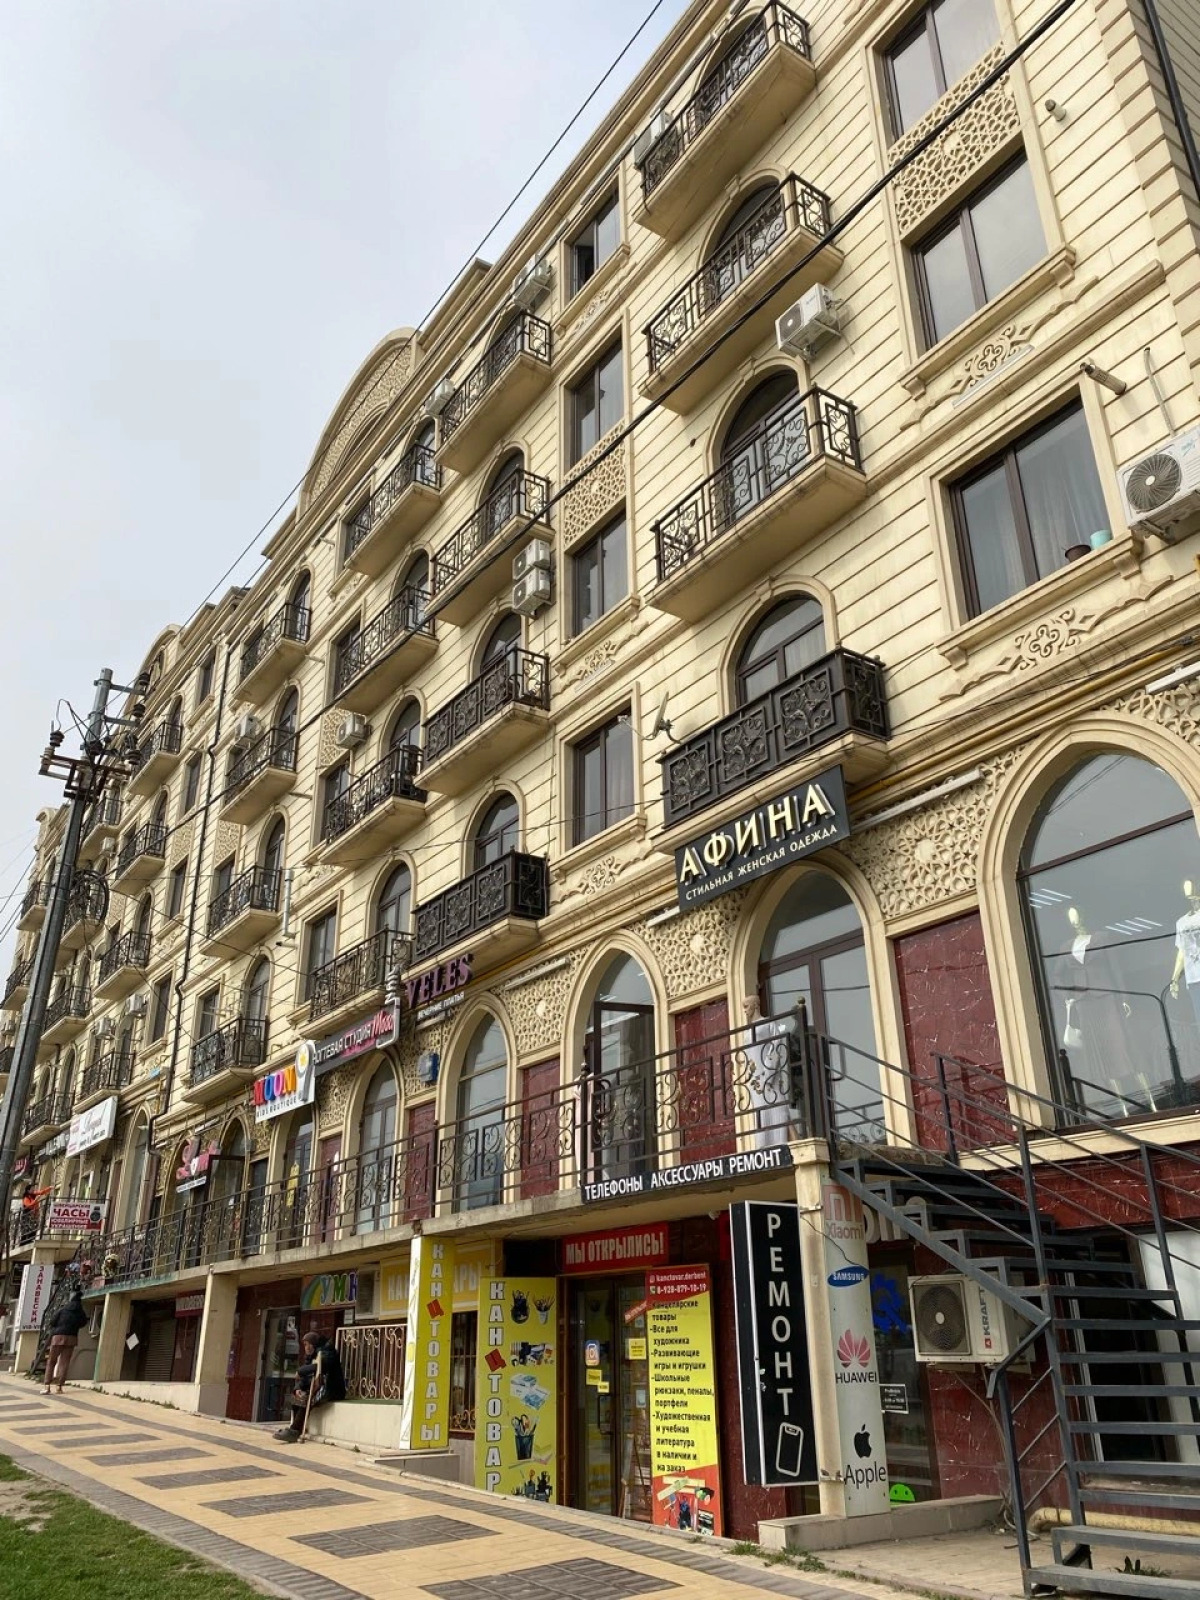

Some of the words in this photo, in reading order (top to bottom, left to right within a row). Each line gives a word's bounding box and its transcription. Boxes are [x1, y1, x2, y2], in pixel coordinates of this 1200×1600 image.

[680, 784, 836, 885] АФИНА
[685, 870, 734, 901] СТИЛЬНАЯ
[737, 848, 786, 877] ЖЕНСКАЯ
[790, 824, 837, 852] ОДЕЖДА
[405, 953, 474, 1009] VELES
[253, 1065, 297, 1106] MOON
[270, 1095, 297, 1113] BOUTIQUE
[585, 1176, 643, 1200] ТЕЛЕФОНЫ
[651, 1162, 724, 1189] АКСЕССУАРЫ
[730, 1149, 782, 1174] РЕМОНТ
[53, 1208, 90, 1217] ЧАСЫ
[825, 1222, 865, 1240] Xiaomi
[565, 1241, 586, 1265] МЫ
[588, 1232, 664, 1262] ОТКРЫЛИСЬ!
[833, 1272, 865, 1281] SAMSUNG
[31, 1265, 45, 1323] ЗАНАВЕСКИ
[766, 1213, 794, 1416] РЕМОНТ
[666, 1326, 678, 1334] для
[653, 1338, 690, 1346] художника
[654, 1362, 671, 1370] игры
[678, 1362, 706, 1371] игрушки
[835, 1371, 877, 1384] HUAWEI
[654, 1387, 686, 1396] рюкзаки,
[655, 1399, 688, 1408] портфели
[662, 1425, 690, 1434] учебная
[656, 1437, 695, 1448] литература
[662, 1451, 692, 1460] наличии
[657, 1464, 666, 1472] на
[666, 1464, 686, 1473] заказ
[844, 1461, 887, 1490] Apple
